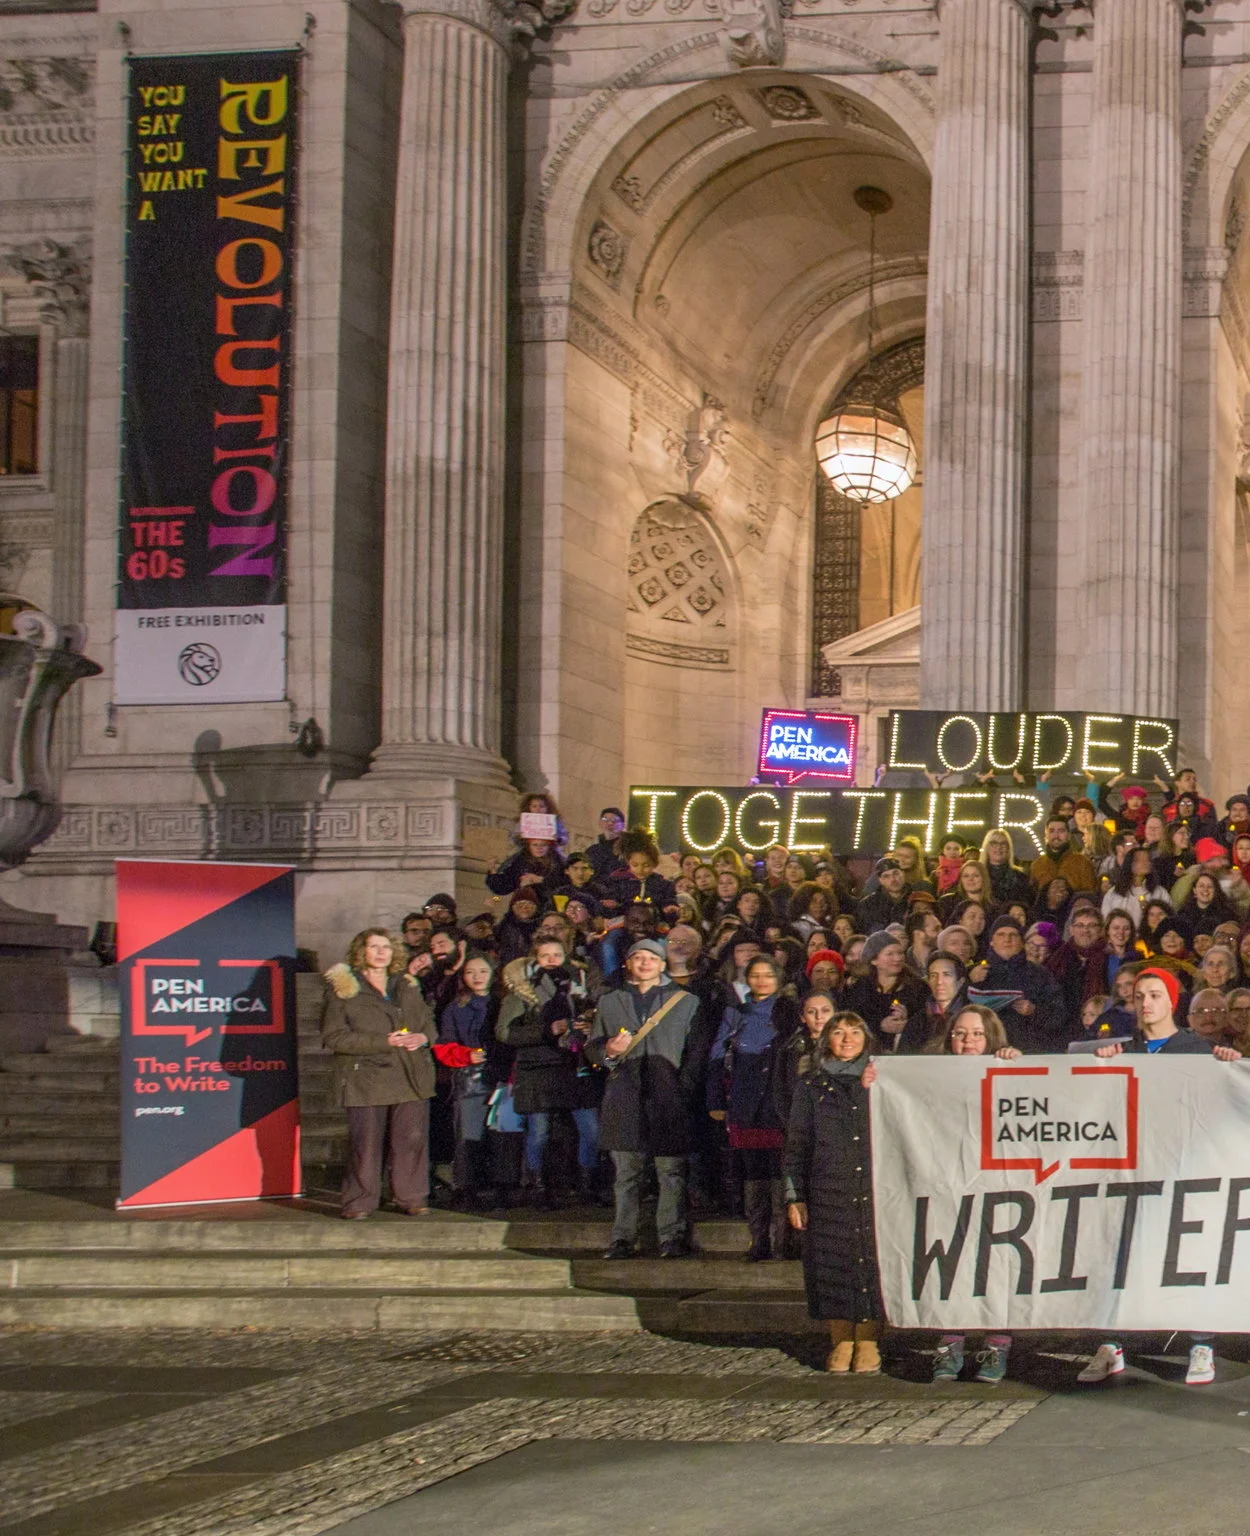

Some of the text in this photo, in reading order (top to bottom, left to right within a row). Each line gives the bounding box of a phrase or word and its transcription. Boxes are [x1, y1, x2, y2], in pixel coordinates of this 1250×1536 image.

[139, 85, 186, 106] YOU
[138, 114, 181, 136] SAY
[139, 142, 184, 164] YOU
[139, 169, 208, 193] WANT
[139, 201, 156, 221] A
[208, 76, 288, 578] REVOLUTION
[132, 520, 184, 548] THE
[127, 548, 186, 580] 60s
[138, 613, 265, 629] FREE EXHIBITION
[769, 726, 813, 744] PEN
[888, 712, 1175, 778] LOUDER
[766, 742, 850, 766] AMERICA
[631, 789, 1046, 856] TOGETHER
[151, 978, 205, 996] PEN
[151, 996, 268, 1013] AMERICA
[133, 1055, 287, 1074] The Freedom
[133, 1076, 231, 1094] to Write
[134, 1104, 185, 1116] pen.org
[998, 1096, 1050, 1118] PEN
[997, 1120, 1118, 1143] AMERICA
